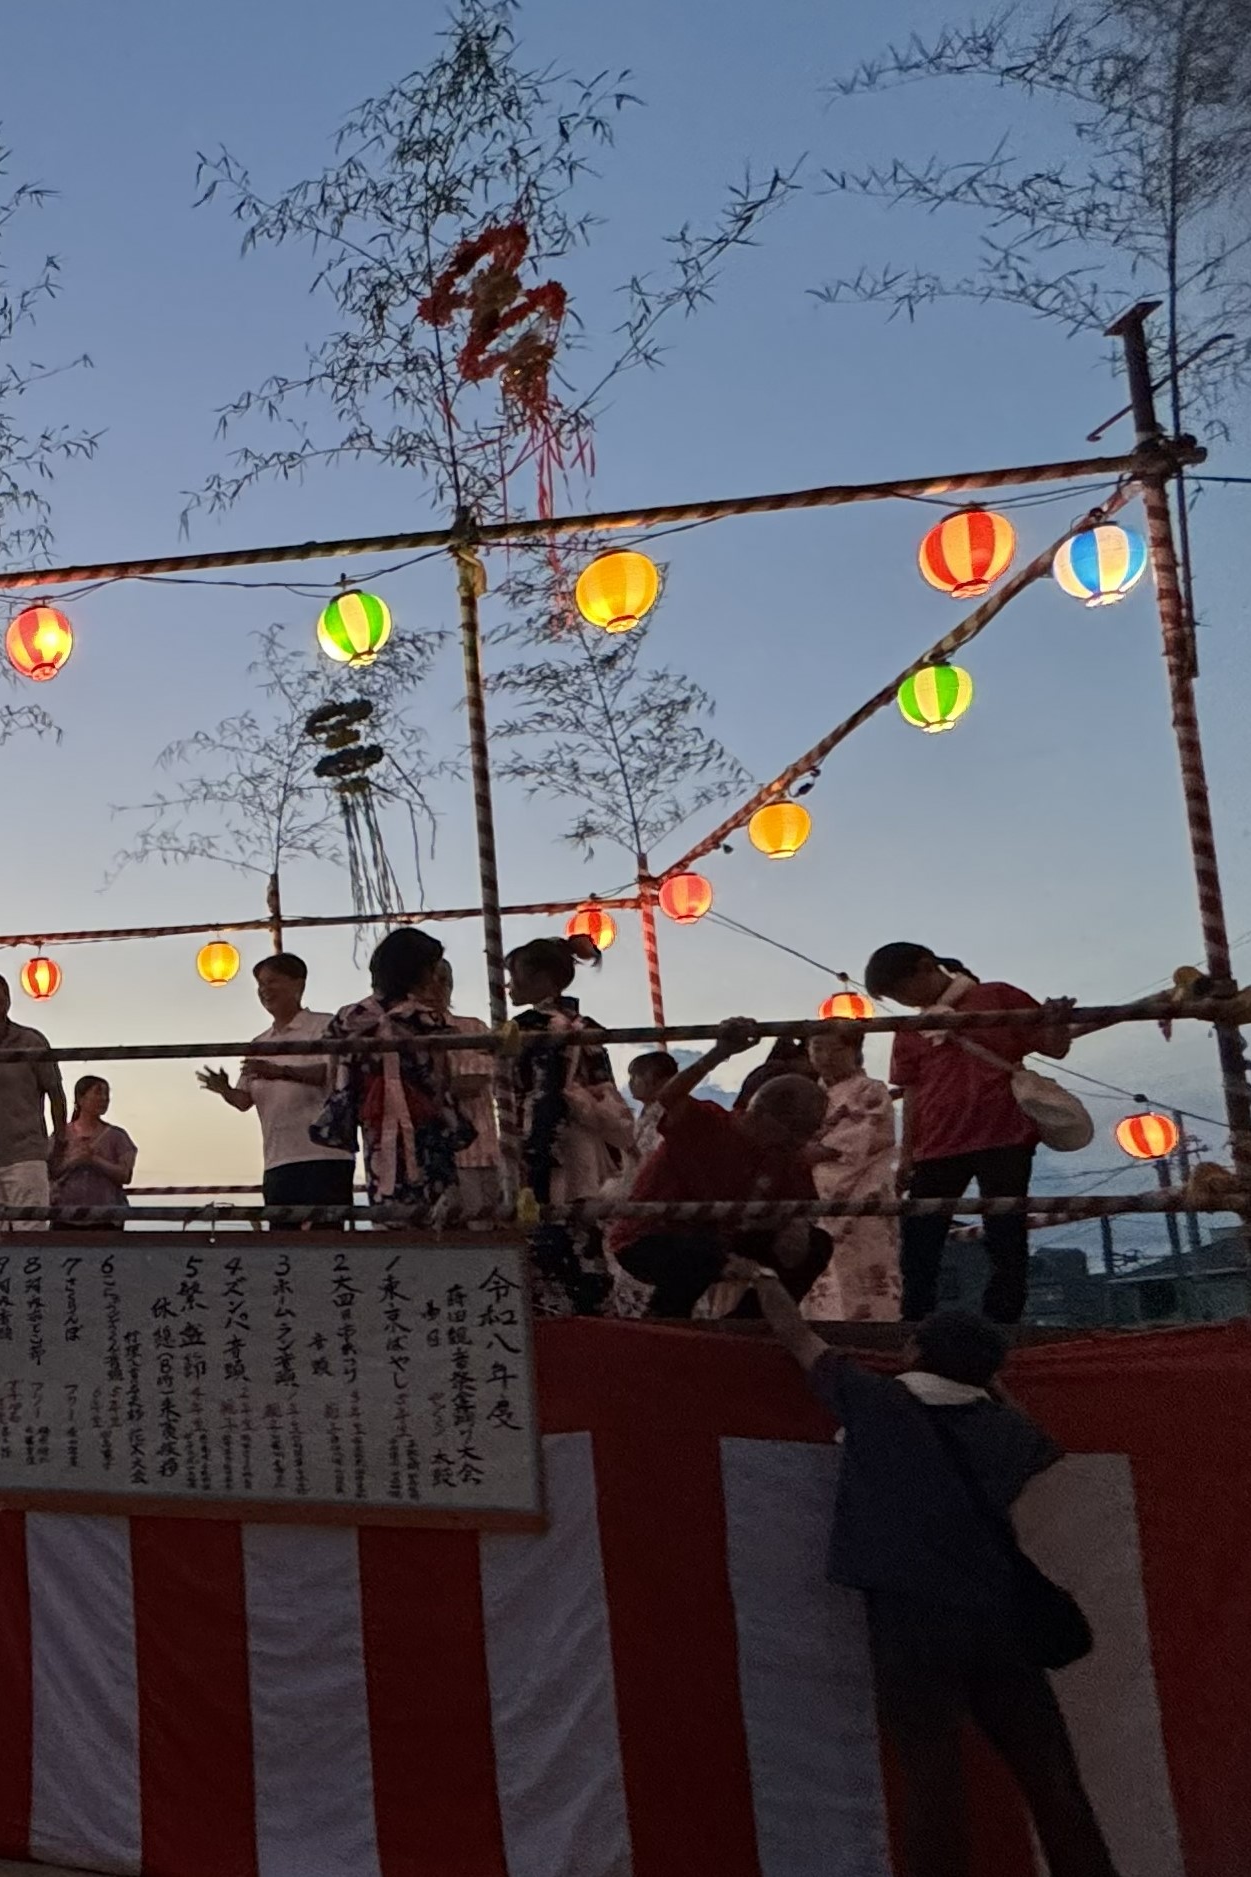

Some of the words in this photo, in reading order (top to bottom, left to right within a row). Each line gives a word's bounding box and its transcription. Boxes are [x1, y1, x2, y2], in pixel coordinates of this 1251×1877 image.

[477, 1266, 524, 1431] 令和八年度
